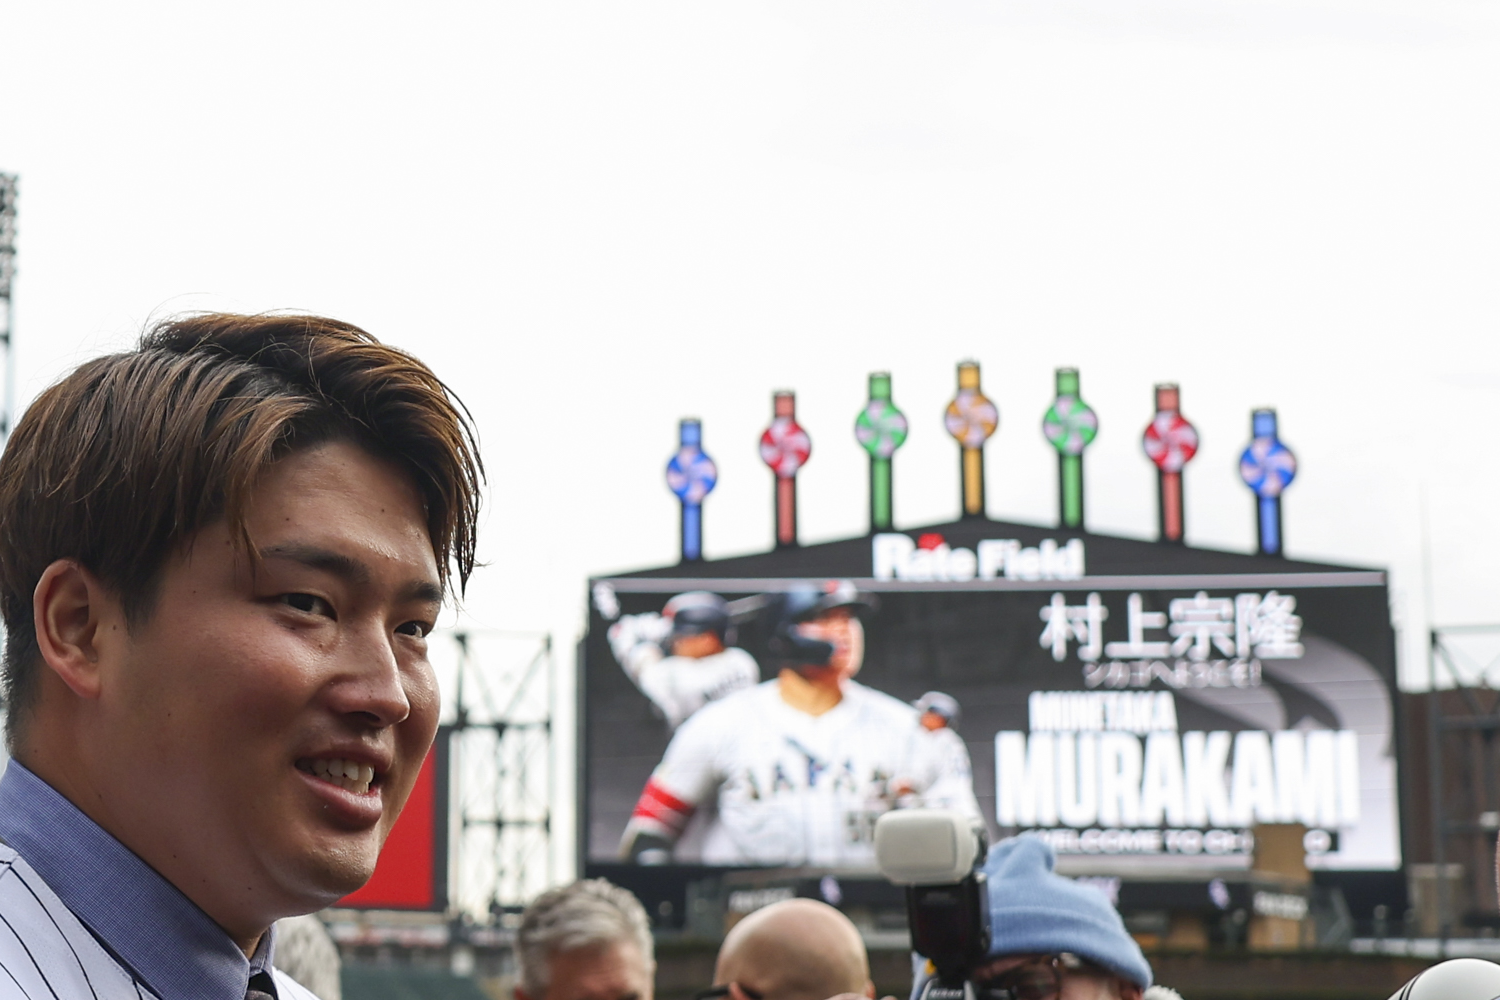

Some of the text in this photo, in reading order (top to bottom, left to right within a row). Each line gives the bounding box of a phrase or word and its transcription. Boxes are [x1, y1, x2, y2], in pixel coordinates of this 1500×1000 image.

[873, 533, 1085, 582] Rate Field
[1039, 591, 1304, 662] 村上宗隆
[996, 731, 1361, 827] MURAKAMI
